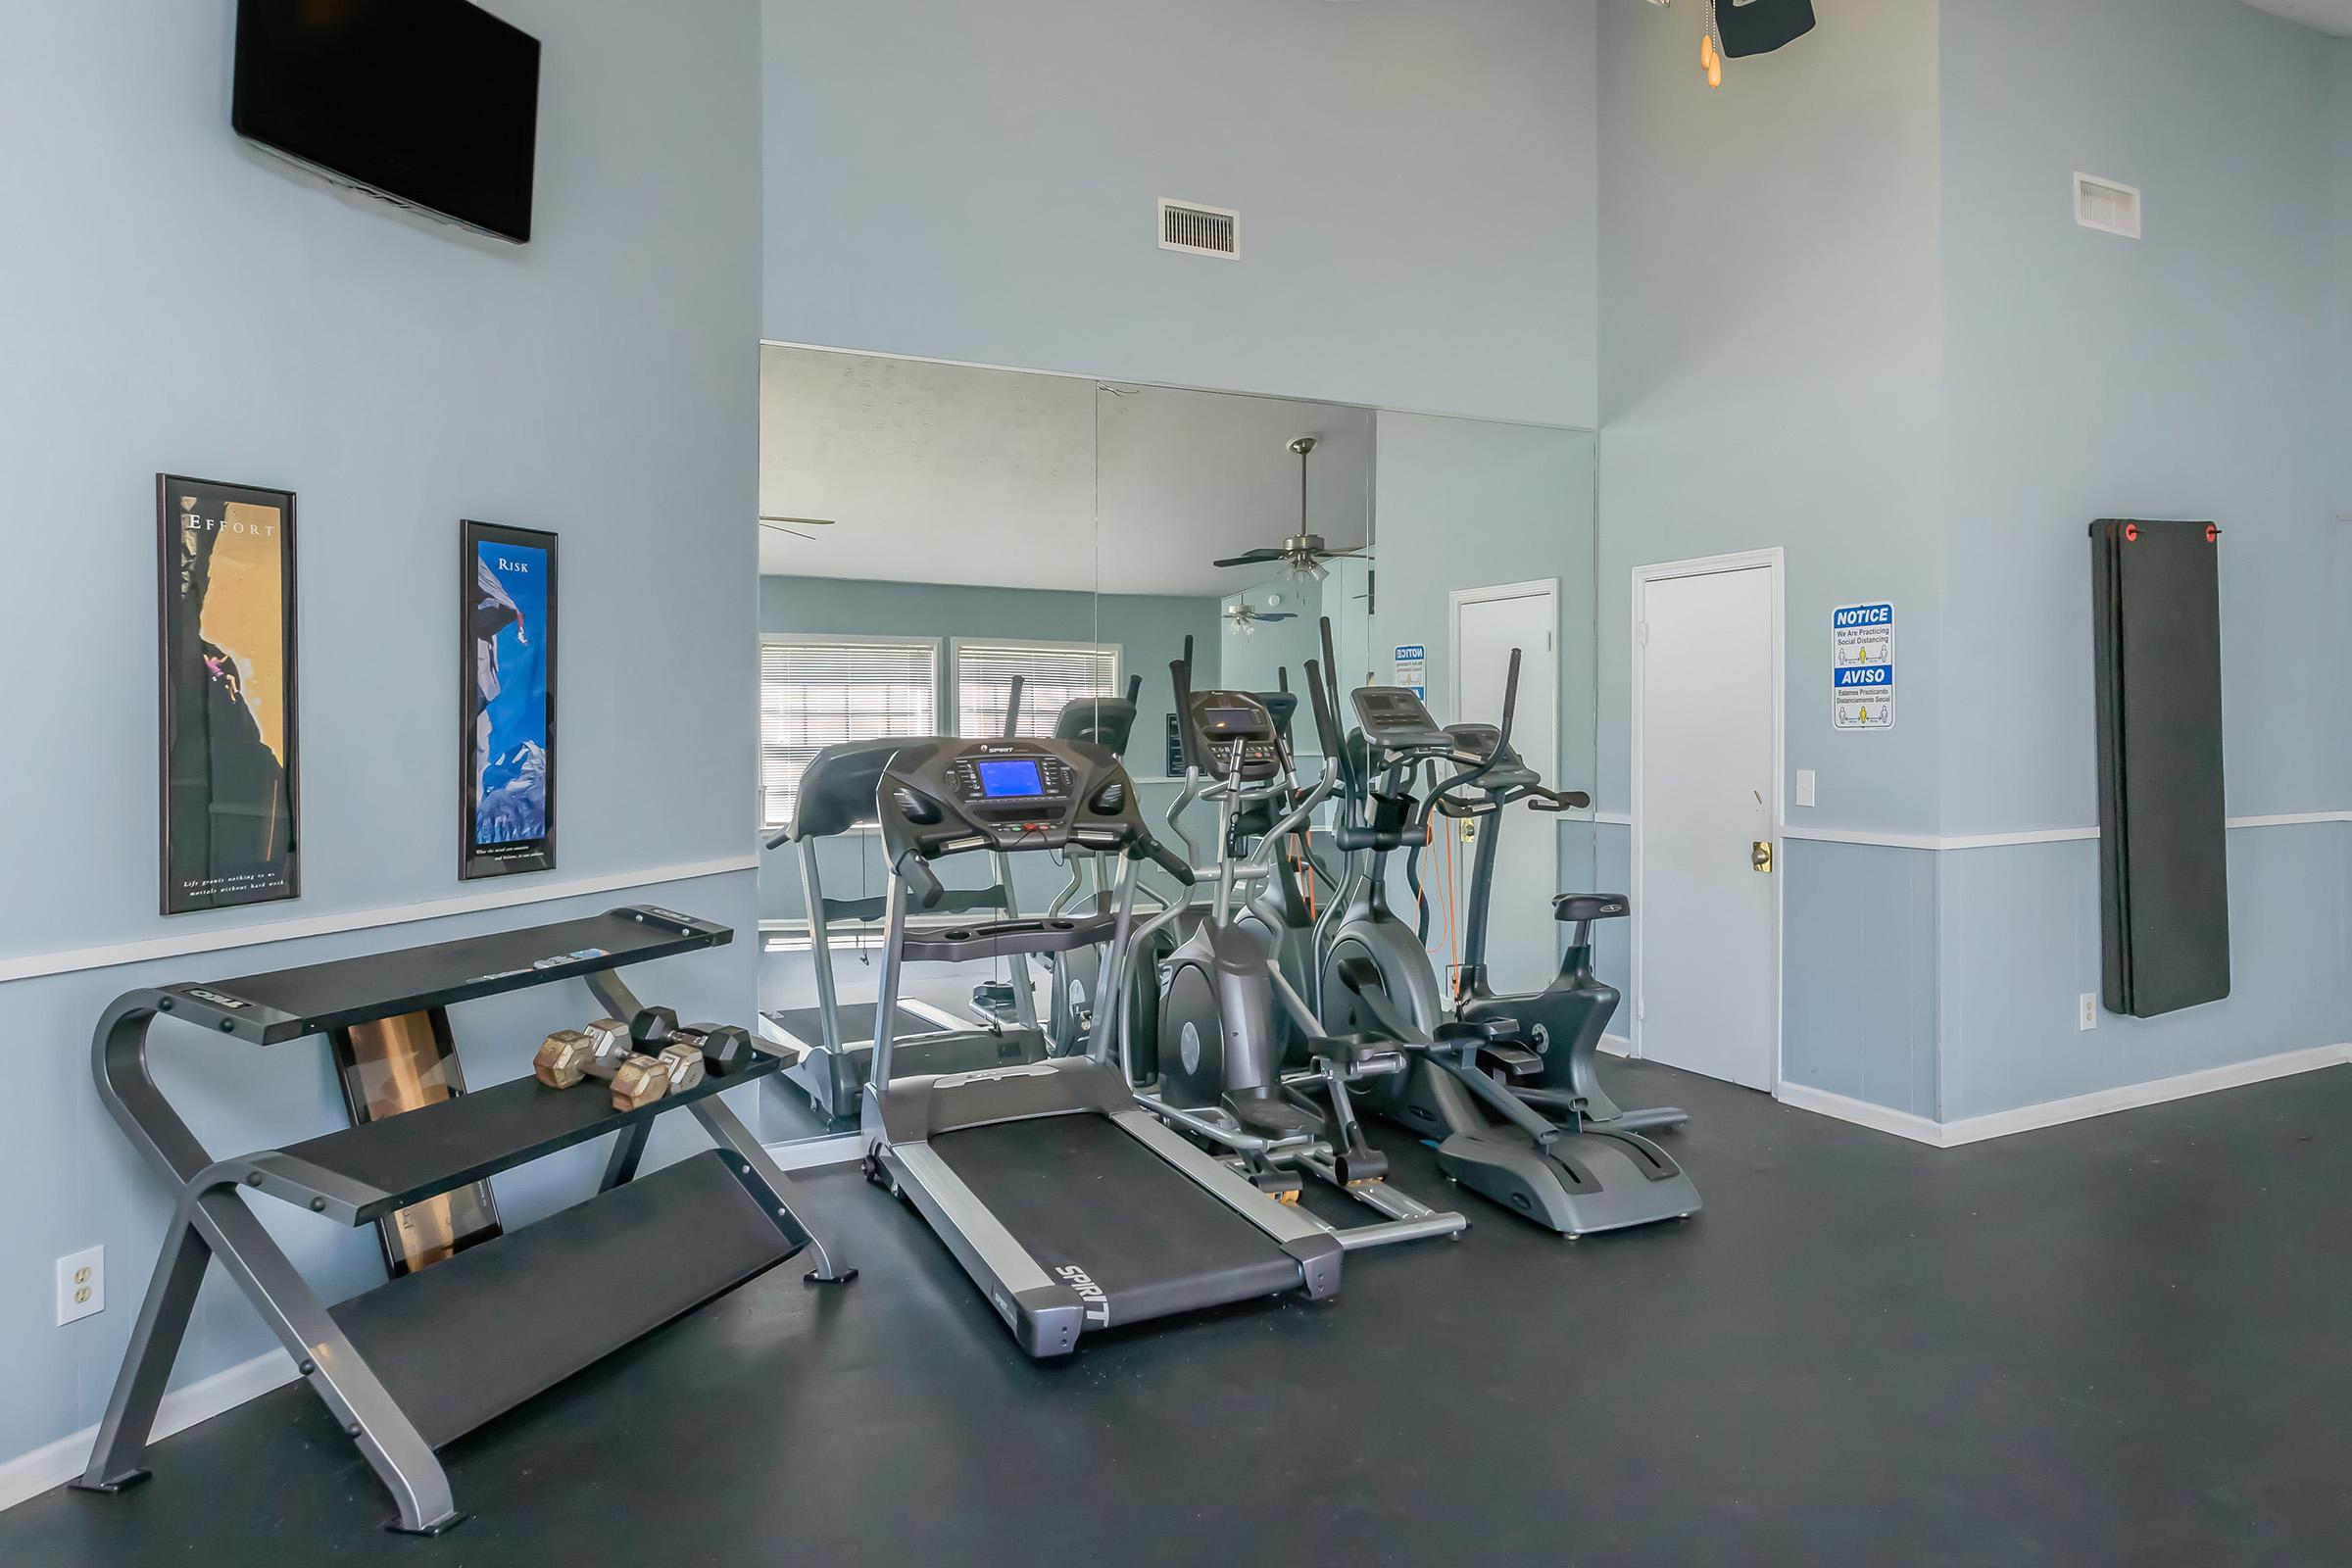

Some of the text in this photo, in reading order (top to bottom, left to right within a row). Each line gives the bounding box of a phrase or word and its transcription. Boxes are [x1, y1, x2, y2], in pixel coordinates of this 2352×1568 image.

[1837, 608, 1888, 625] NOTICE
[1841, 668, 1886, 684] AVISO
[1054, 1265, 1109, 1328] SPIRIT
